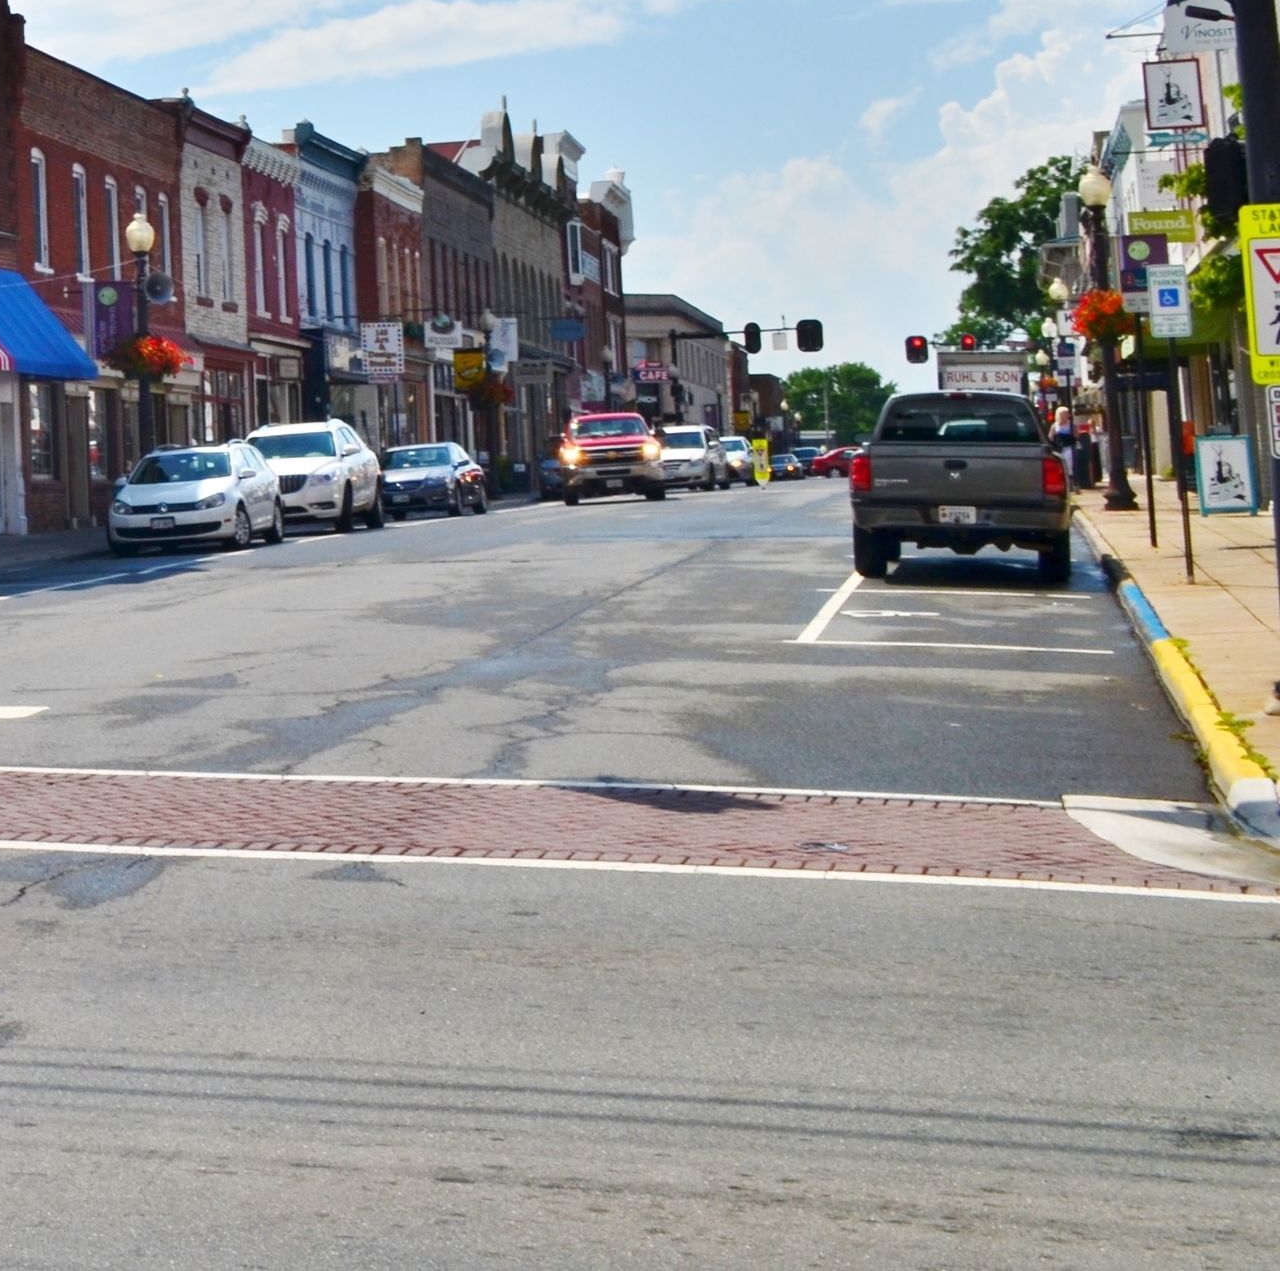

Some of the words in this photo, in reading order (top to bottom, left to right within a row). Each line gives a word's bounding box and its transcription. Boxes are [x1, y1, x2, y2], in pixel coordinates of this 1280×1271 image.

[1180, 23, 1234, 40] VINOSIT
[1259, 222, 1280, 234] LA
[639, 370, 669, 380] CAFE
[947, 372, 976, 383] RUHL
[981, 372, 988, 383] &
[995, 371, 1018, 383] SON
